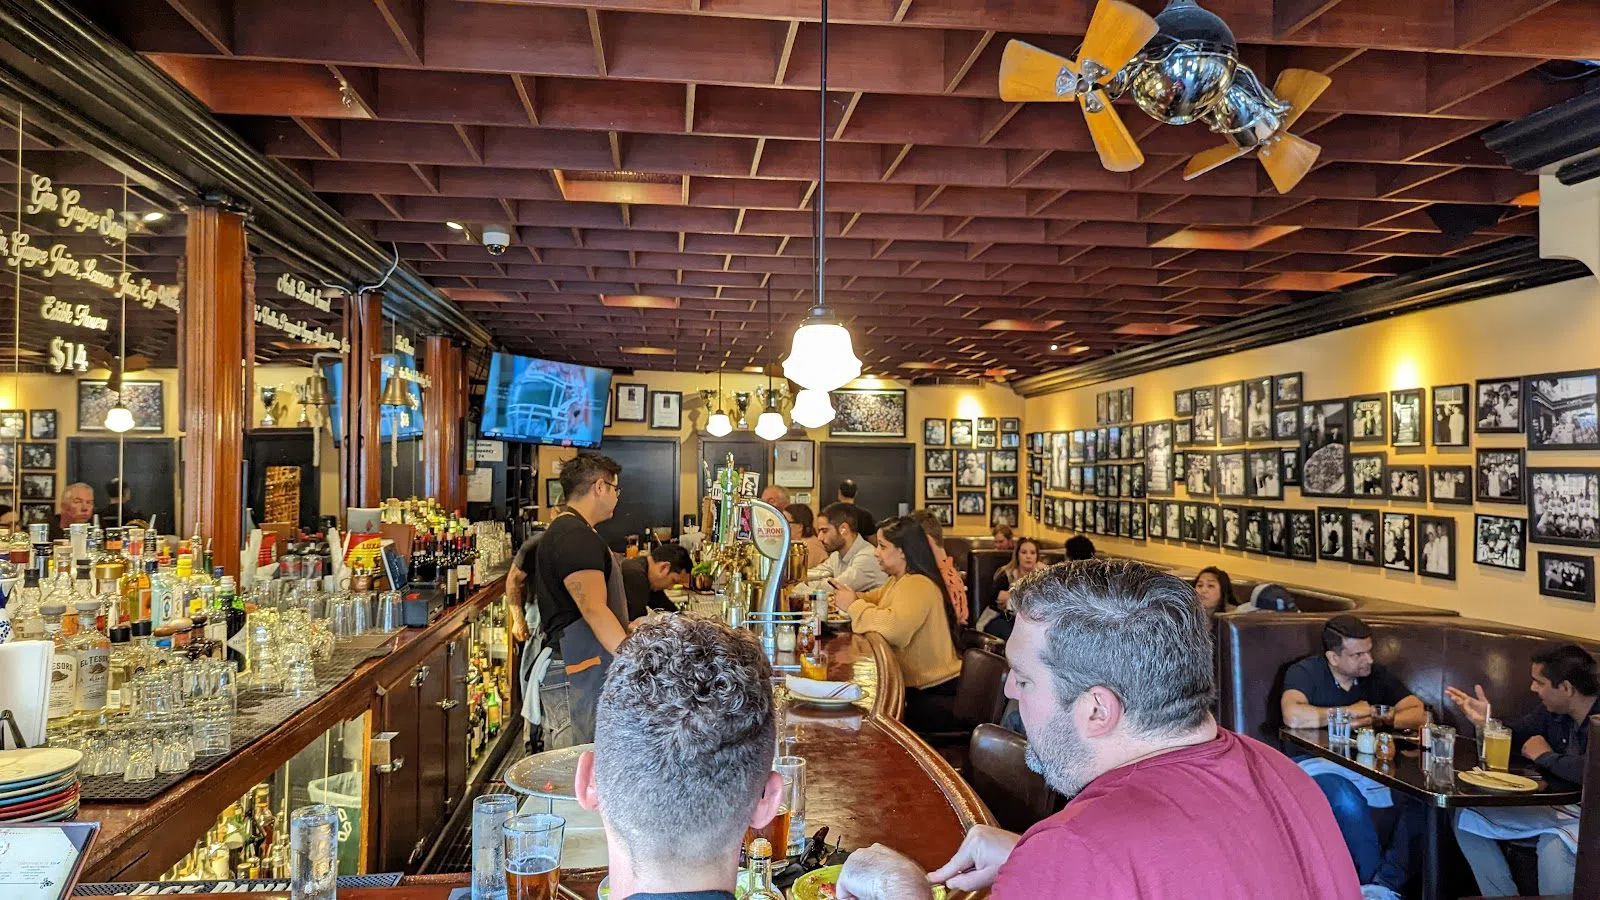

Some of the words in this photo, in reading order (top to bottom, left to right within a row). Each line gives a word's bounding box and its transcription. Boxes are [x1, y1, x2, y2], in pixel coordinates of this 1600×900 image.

[49, 336, 88, 372] $14
[114, 883, 204, 897] JACK
[209, 881, 292, 894] DANI
